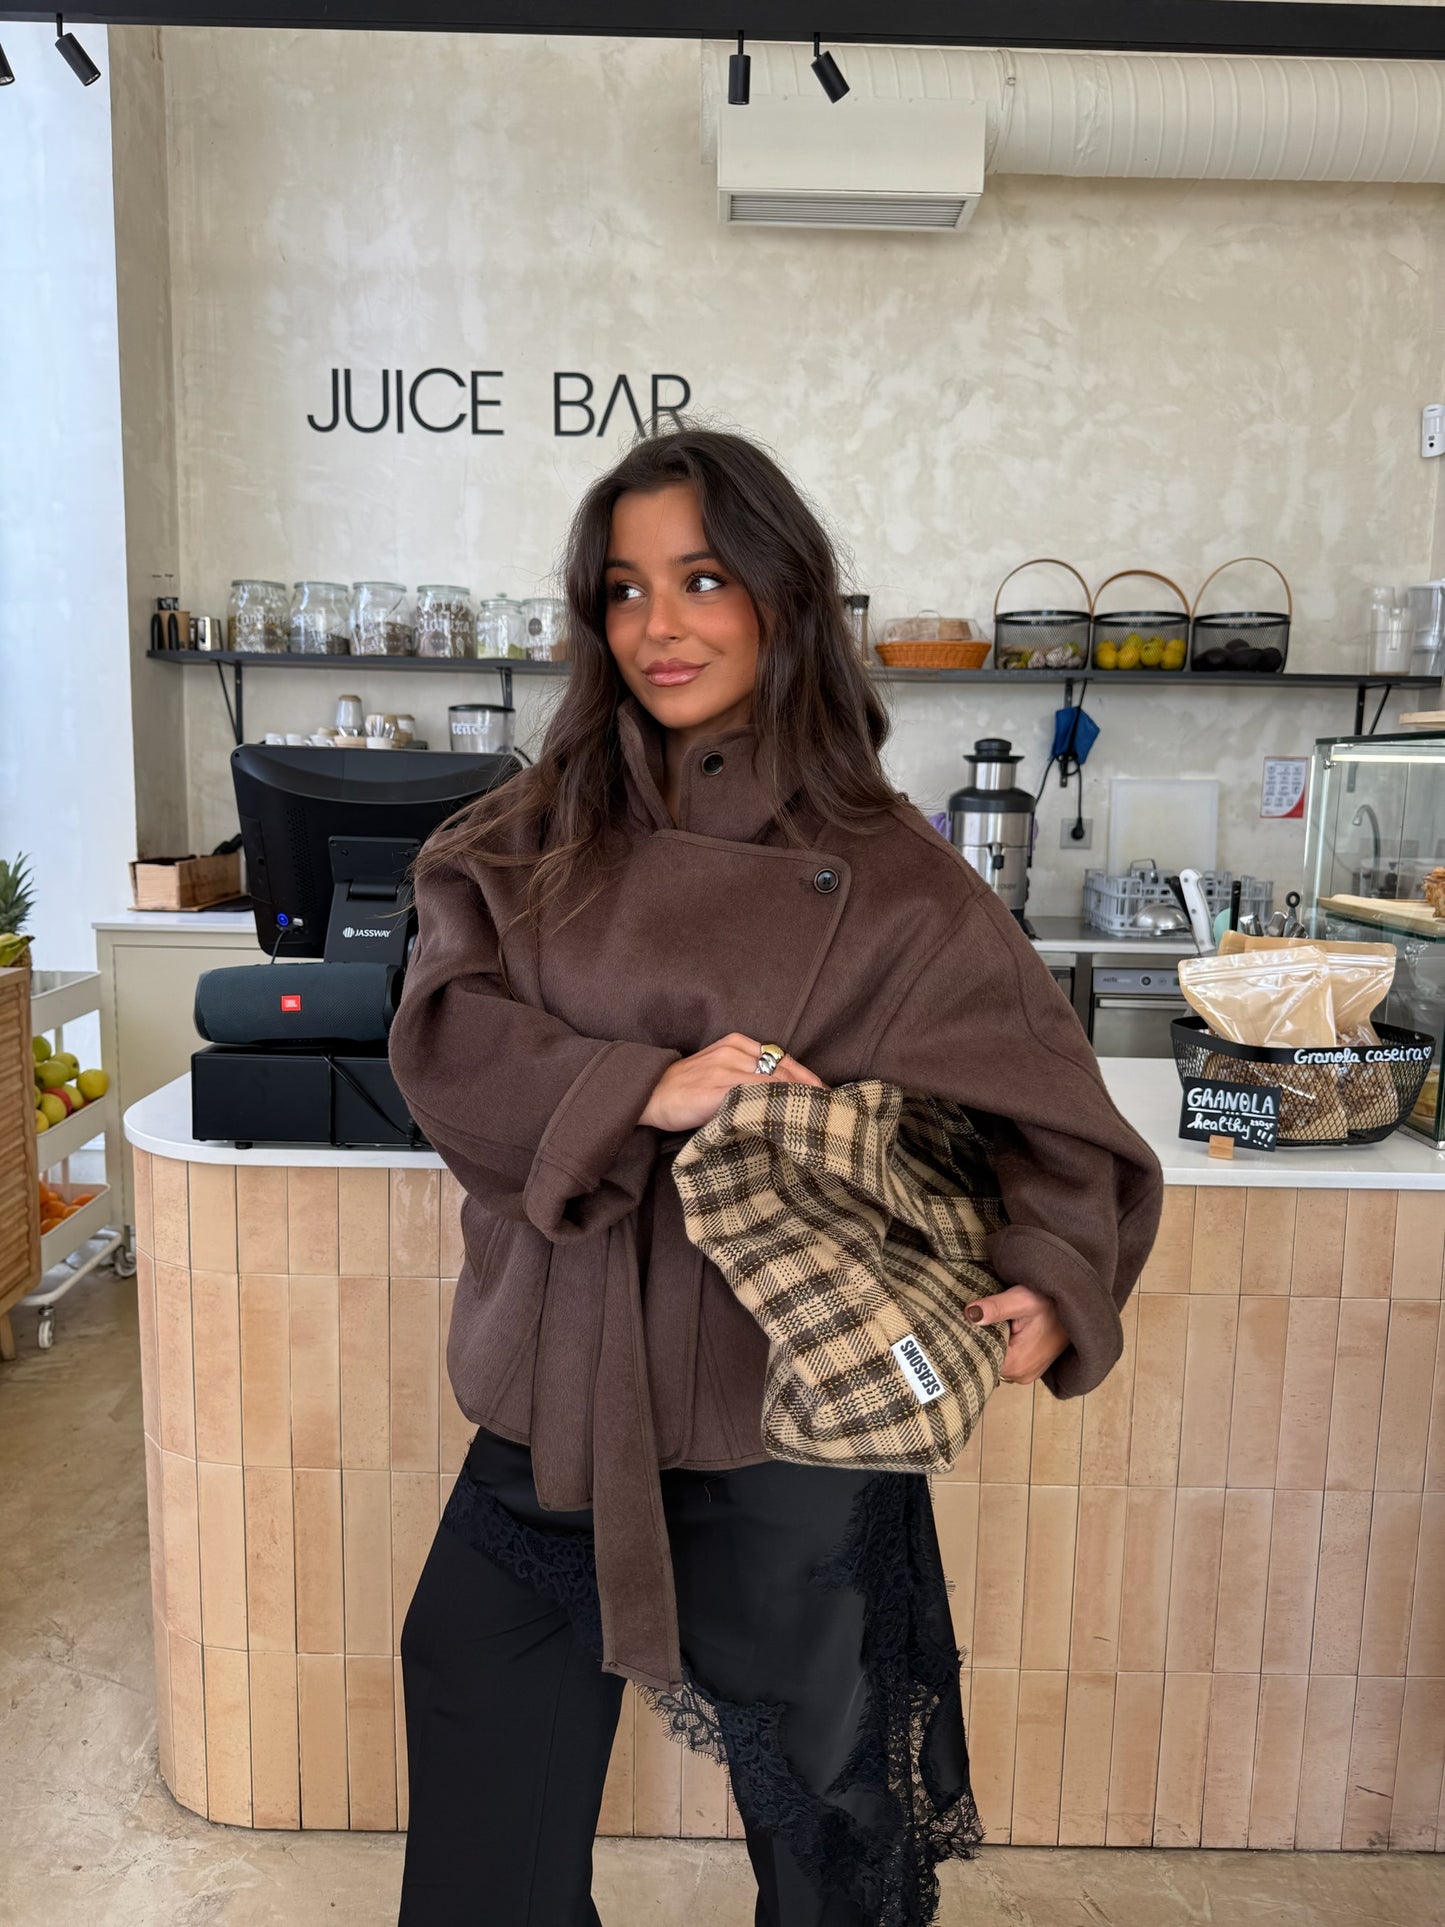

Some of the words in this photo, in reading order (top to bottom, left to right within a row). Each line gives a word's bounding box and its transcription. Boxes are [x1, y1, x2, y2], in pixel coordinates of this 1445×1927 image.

[307, 367, 504, 436] JUICE
[553, 371, 691, 438] BAR
[355, 929, 391, 938] JASSWAY
[1293, 1047, 1361, 1065] Granola
[1365, 1045, 1424, 1063] caseira
[1186, 1086, 1275, 1115] GRANOLA
[1186, 1112, 1251, 1140] healthy
[900, 1340, 941, 1396] SEASONS
